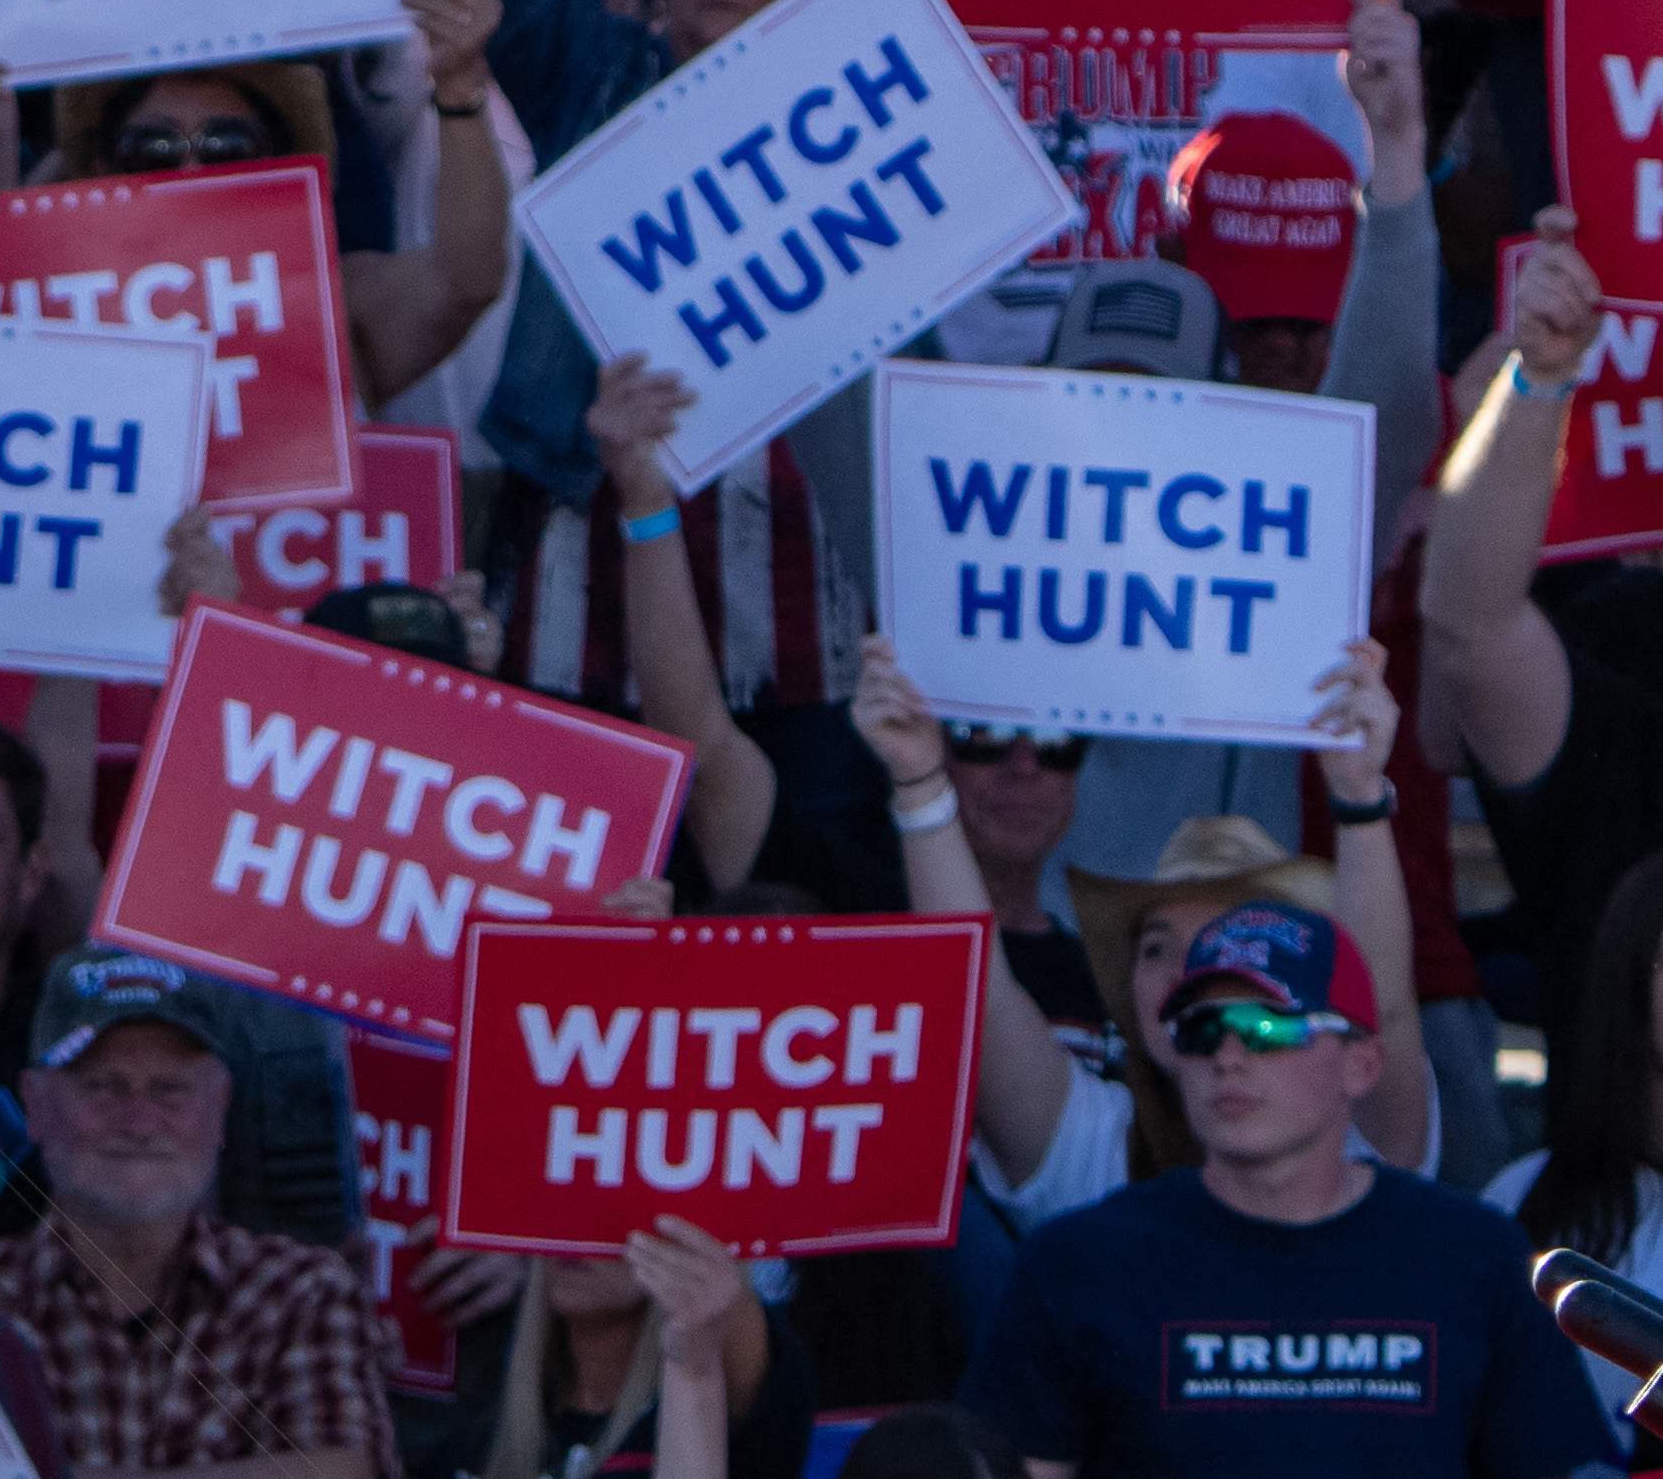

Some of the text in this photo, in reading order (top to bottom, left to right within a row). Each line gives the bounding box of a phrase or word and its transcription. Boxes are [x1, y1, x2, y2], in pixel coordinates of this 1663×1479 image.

[599, 35, 932, 294] WITCH
[677, 137, 947, 369] HUNT
[928, 457, 1309, 558] WITCH
[958, 561, 1274, 654] HUNT
[220, 697, 612, 889] WITCH
[519, 1002, 923, 1090] WITCH
[547, 1104, 884, 1190] HUNT
[1185, 1333, 1423, 1372] TRUMP
